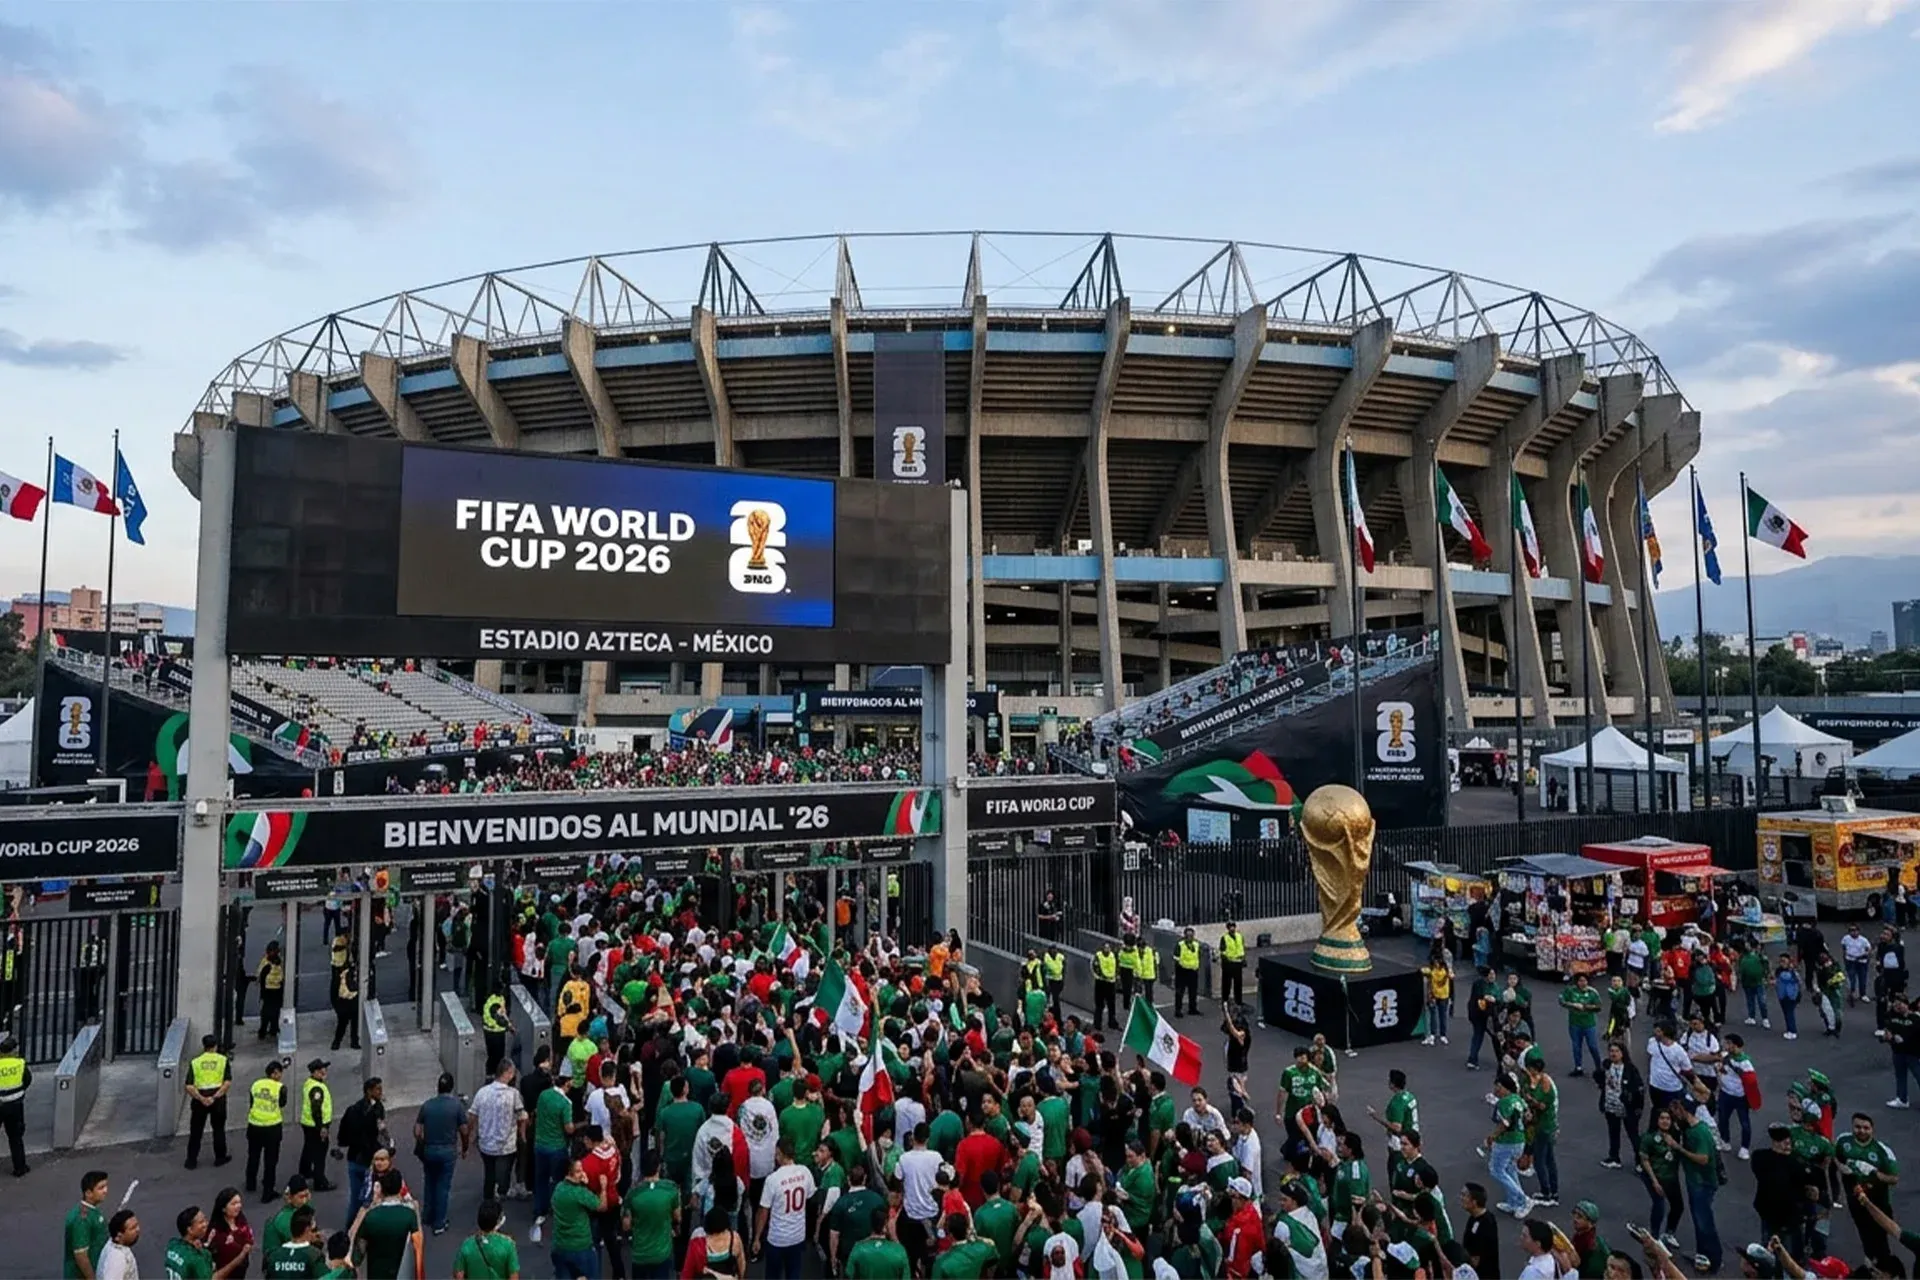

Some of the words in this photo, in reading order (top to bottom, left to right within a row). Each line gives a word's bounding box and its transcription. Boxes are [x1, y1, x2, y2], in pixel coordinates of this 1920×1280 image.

[456, 499, 545, 534] FIFA
[551, 505, 696, 541] WORLD
[481, 536, 566, 569] CUP
[575, 541, 671, 574] 2026
[480, 629, 579, 650] ESTADIO
[585, 631, 673, 652] AZTECA
[693, 630, 774, 654] MÉXICO
[986, 800, 1019, 814] FIFA
[1069, 796, 1095, 810] CUP
[384, 814, 602, 848] BIENVENIDOS
[609, 812, 647, 838] AL
[653, 807, 783, 836] MUNDIAL
[789, 805, 829, 830] '26
[56, 840, 93, 854] CUP
[95, 838, 139, 852] 2026
[784, 1187, 805, 1213] 10
